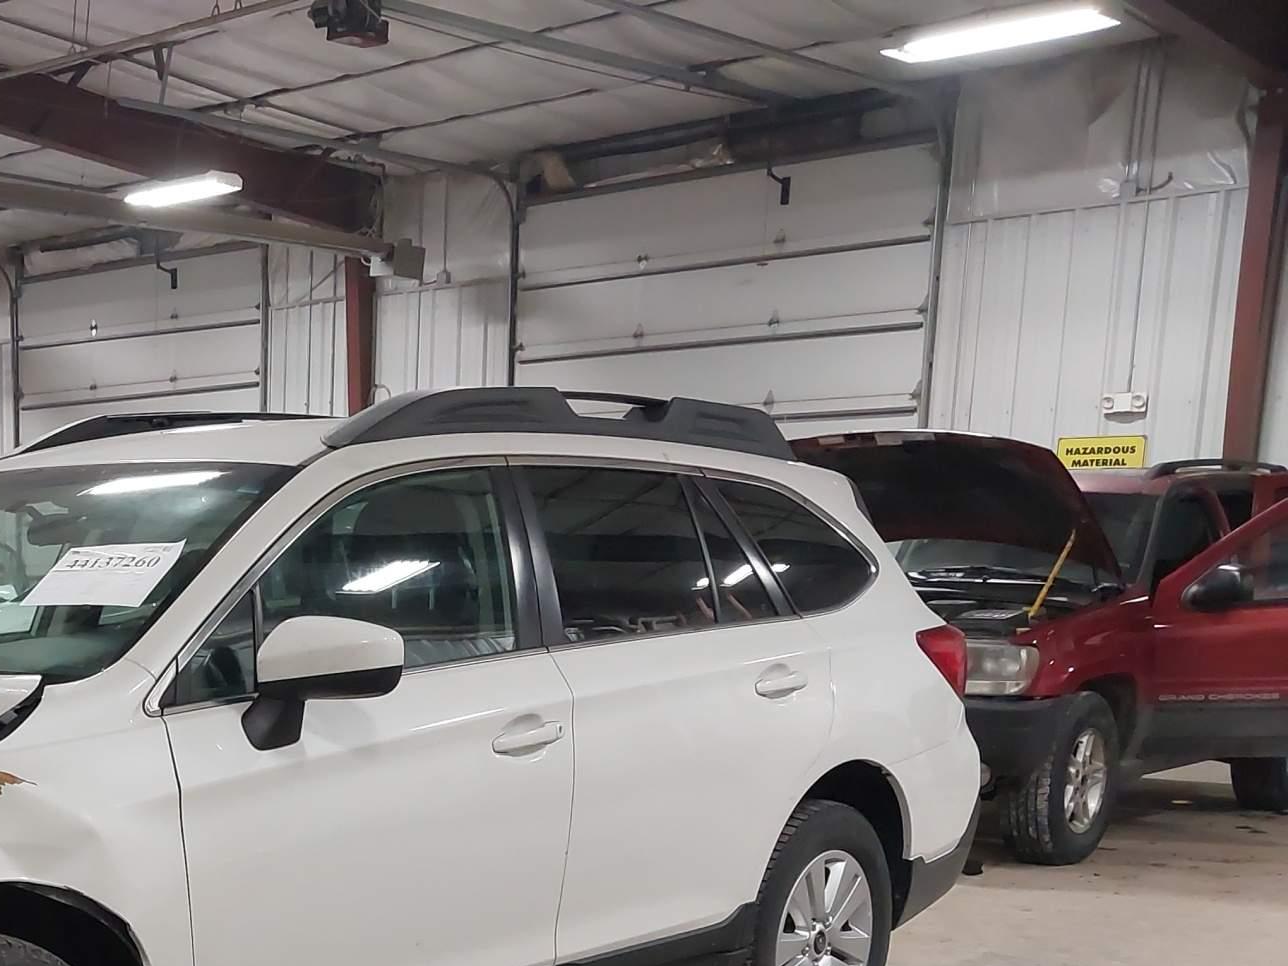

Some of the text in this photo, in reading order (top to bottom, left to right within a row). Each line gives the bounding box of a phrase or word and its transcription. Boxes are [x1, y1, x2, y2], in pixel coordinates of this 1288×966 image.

[1065, 445, 1136, 456] HAZARDOUS
[1071, 458, 1127, 468] MATERIAL
[66, 556, 161, 569] 44137260
